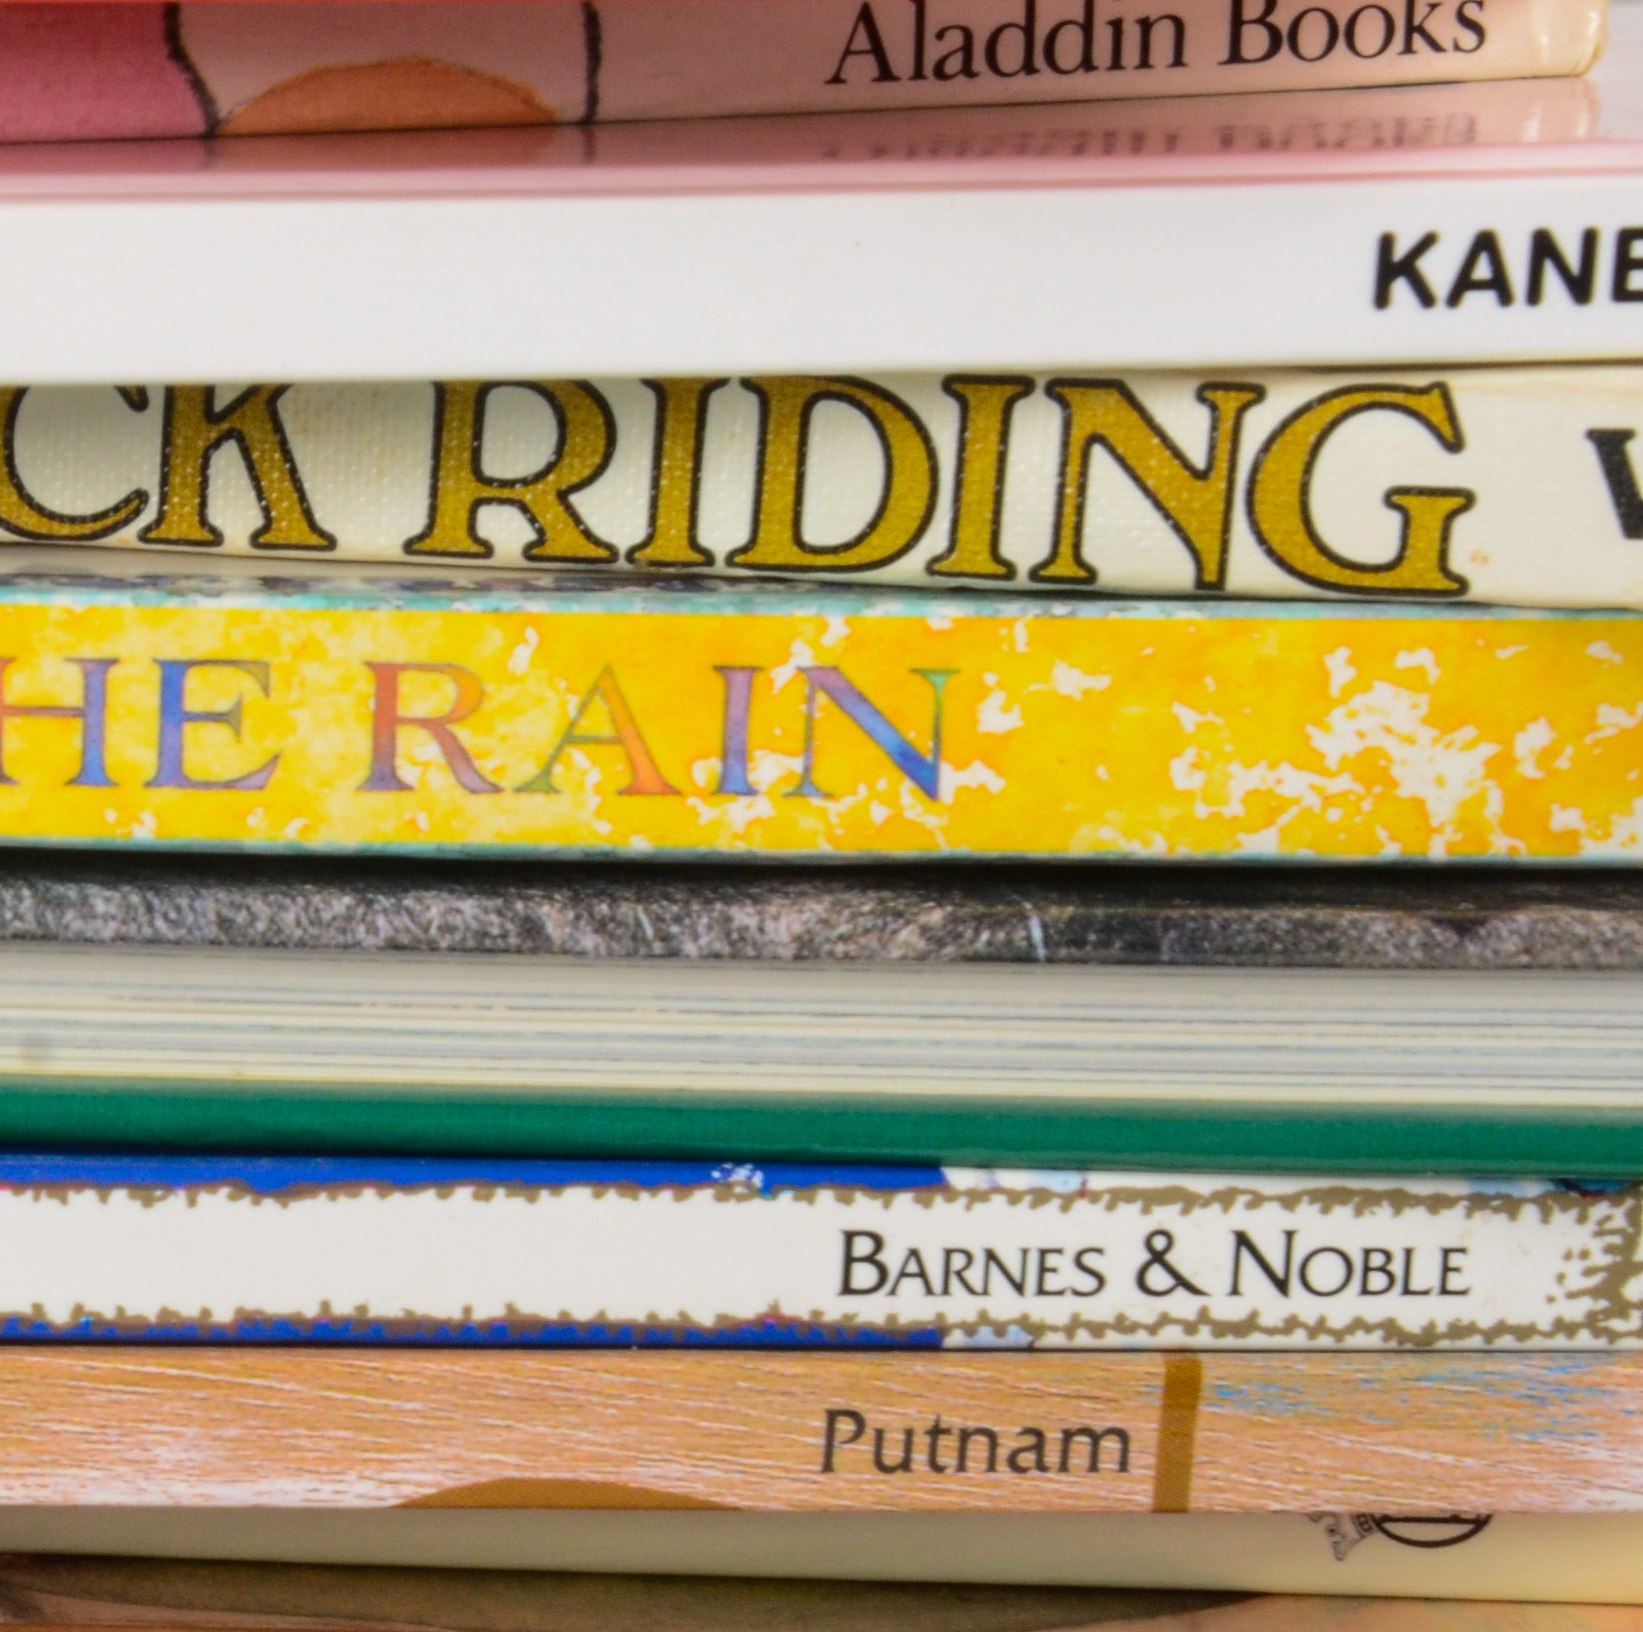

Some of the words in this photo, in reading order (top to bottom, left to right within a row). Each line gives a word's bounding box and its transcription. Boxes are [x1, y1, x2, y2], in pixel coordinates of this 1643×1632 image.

[824, 0, 1190, 85] Aladdin
[1217, 0, 1488, 66] Books
[403, 374, 1477, 597] RIDING
[359, 659, 953, 803] RAIN
[837, 1229, 1106, 1298] BARNES
[1135, 1229, 1211, 1298] &
[1228, 1229, 1470, 1298] NOBLE
[820, 1408, 1132, 1476] Putnam
